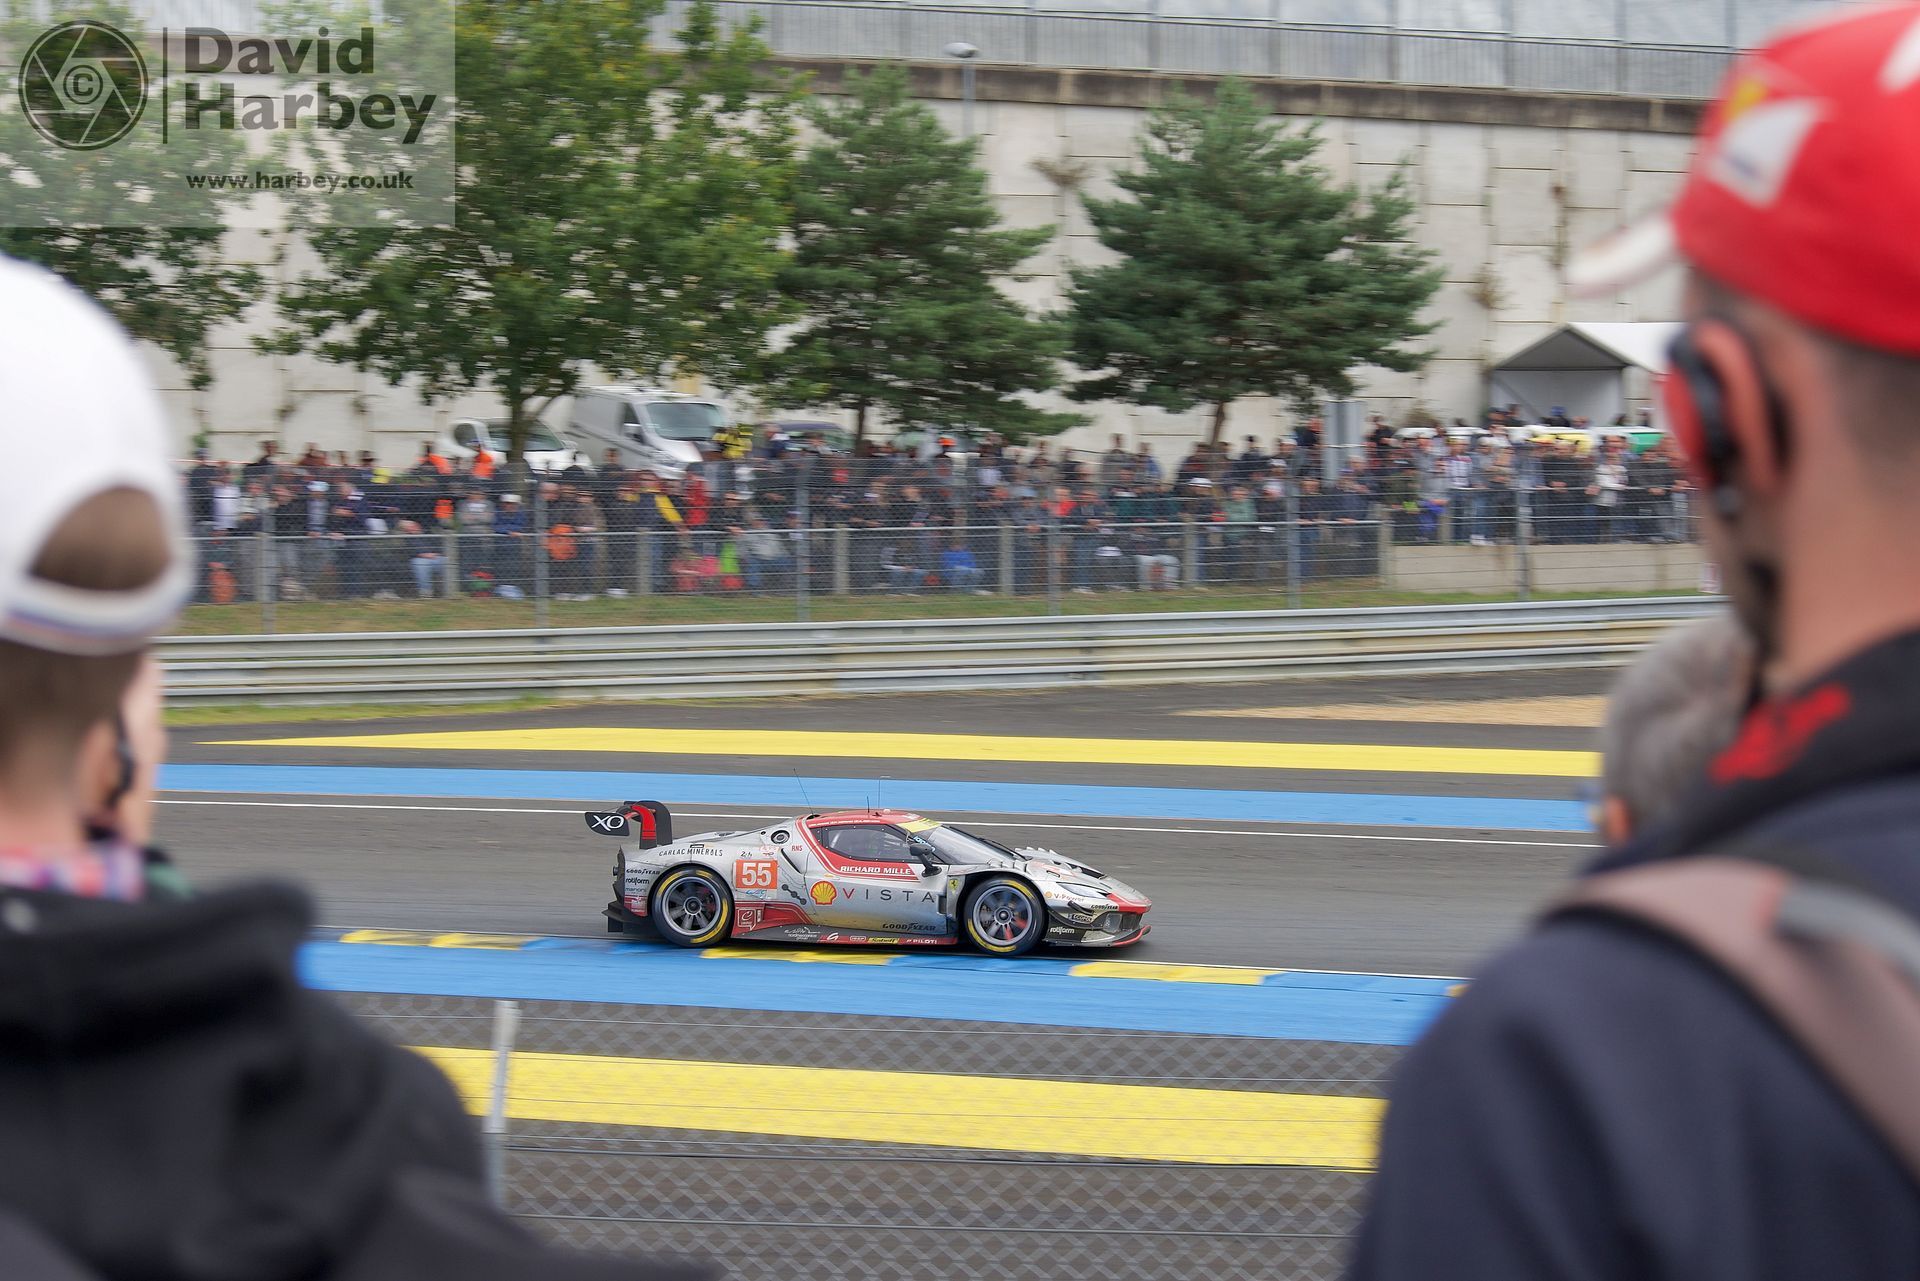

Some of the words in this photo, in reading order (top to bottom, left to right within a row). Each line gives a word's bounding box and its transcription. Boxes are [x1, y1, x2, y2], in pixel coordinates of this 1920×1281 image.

[591, 815, 625, 832] XO
[741, 862, 772, 887] 55
[840, 865, 881, 873] RICHARD
[883, 866, 911, 875] MILLE
[842, 888, 935, 903] VISTA
[882, 923, 936, 932] GOODYEAR
